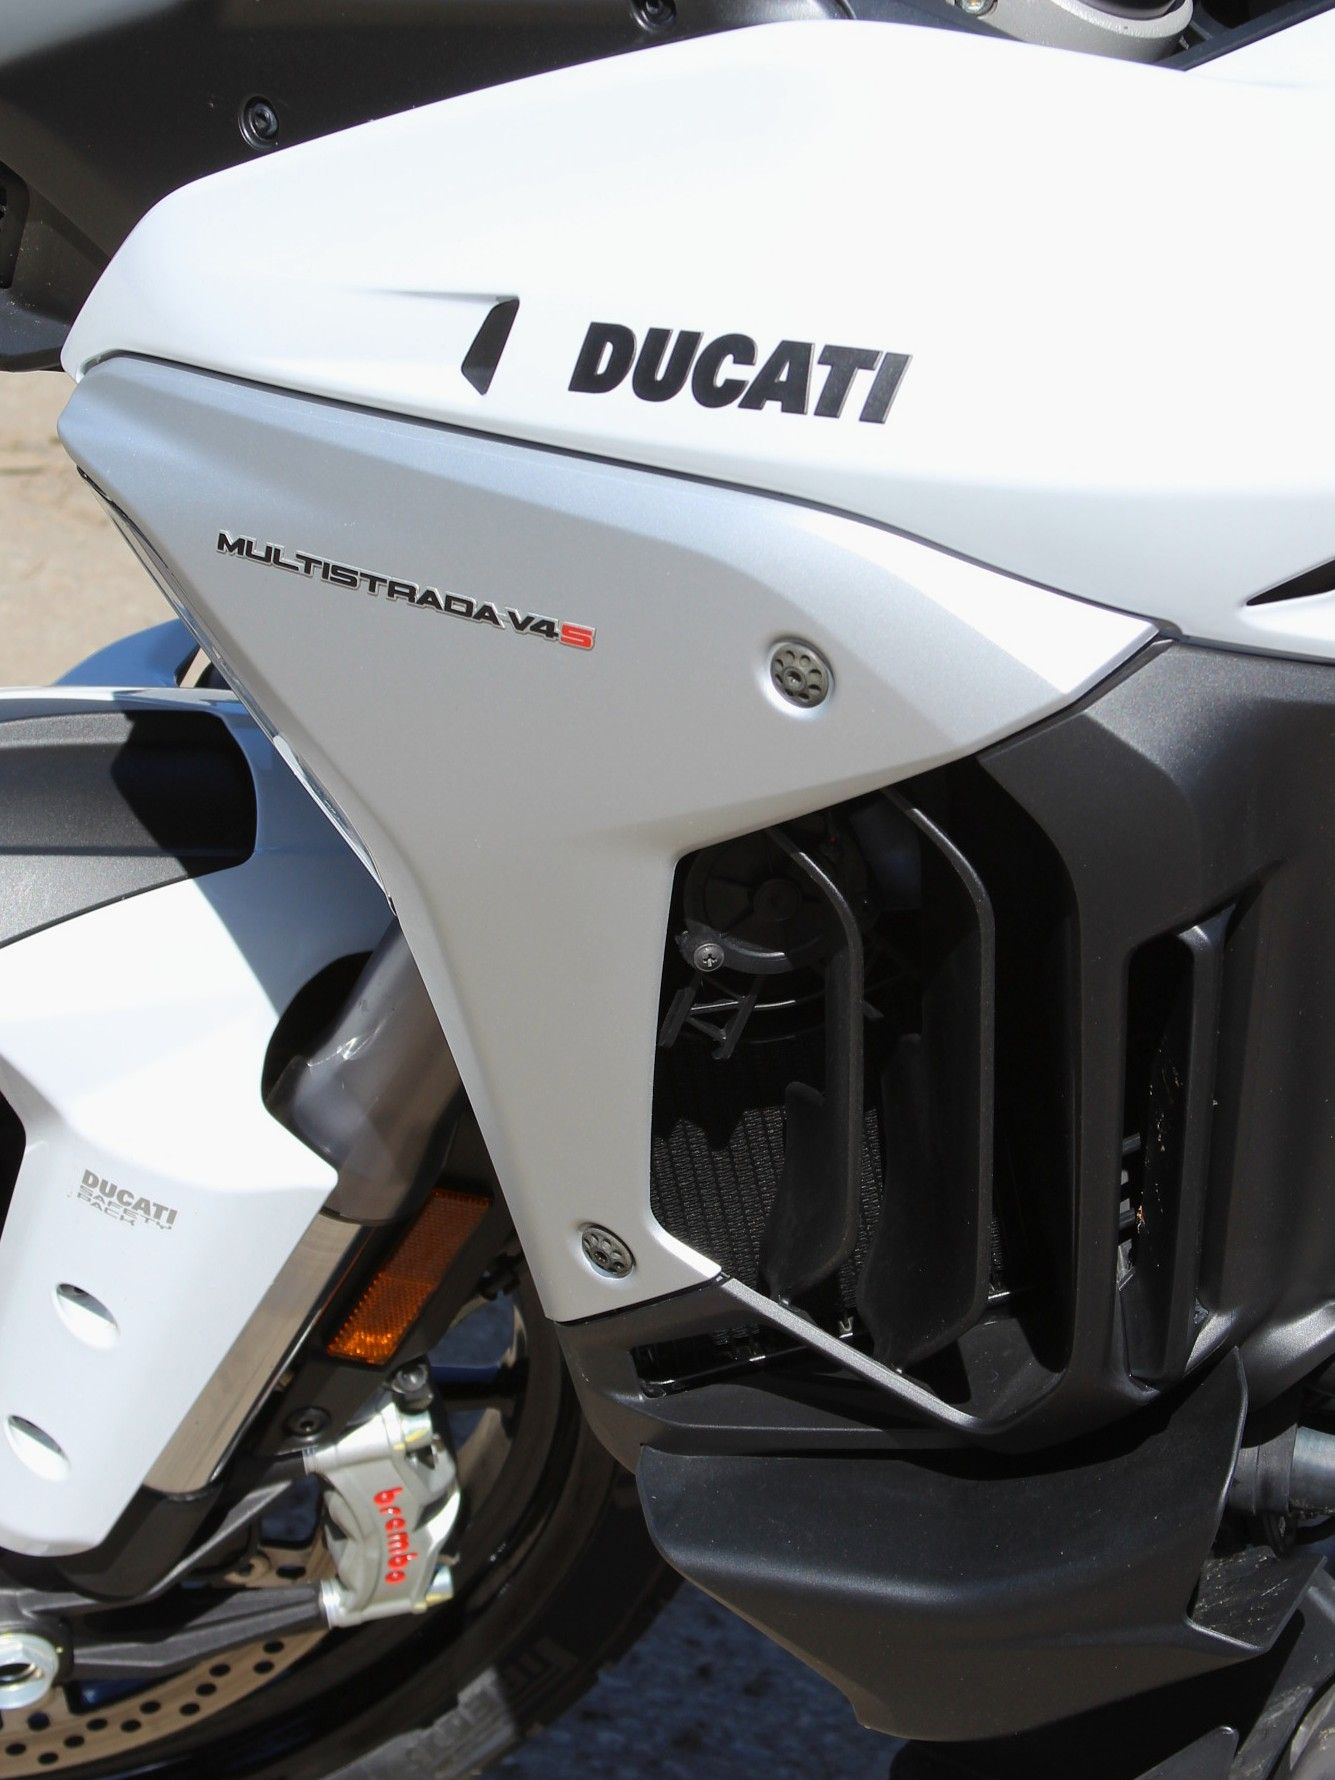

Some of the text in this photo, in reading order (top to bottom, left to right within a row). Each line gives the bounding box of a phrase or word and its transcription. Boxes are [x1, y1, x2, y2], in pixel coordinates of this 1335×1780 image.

[568, 321, 913, 424] DUCATI
[216, 530, 597, 650] MULTISTRADA V4S
[81, 1168, 178, 1225] DUCATI
[373, 1487, 418, 1584] brembo
